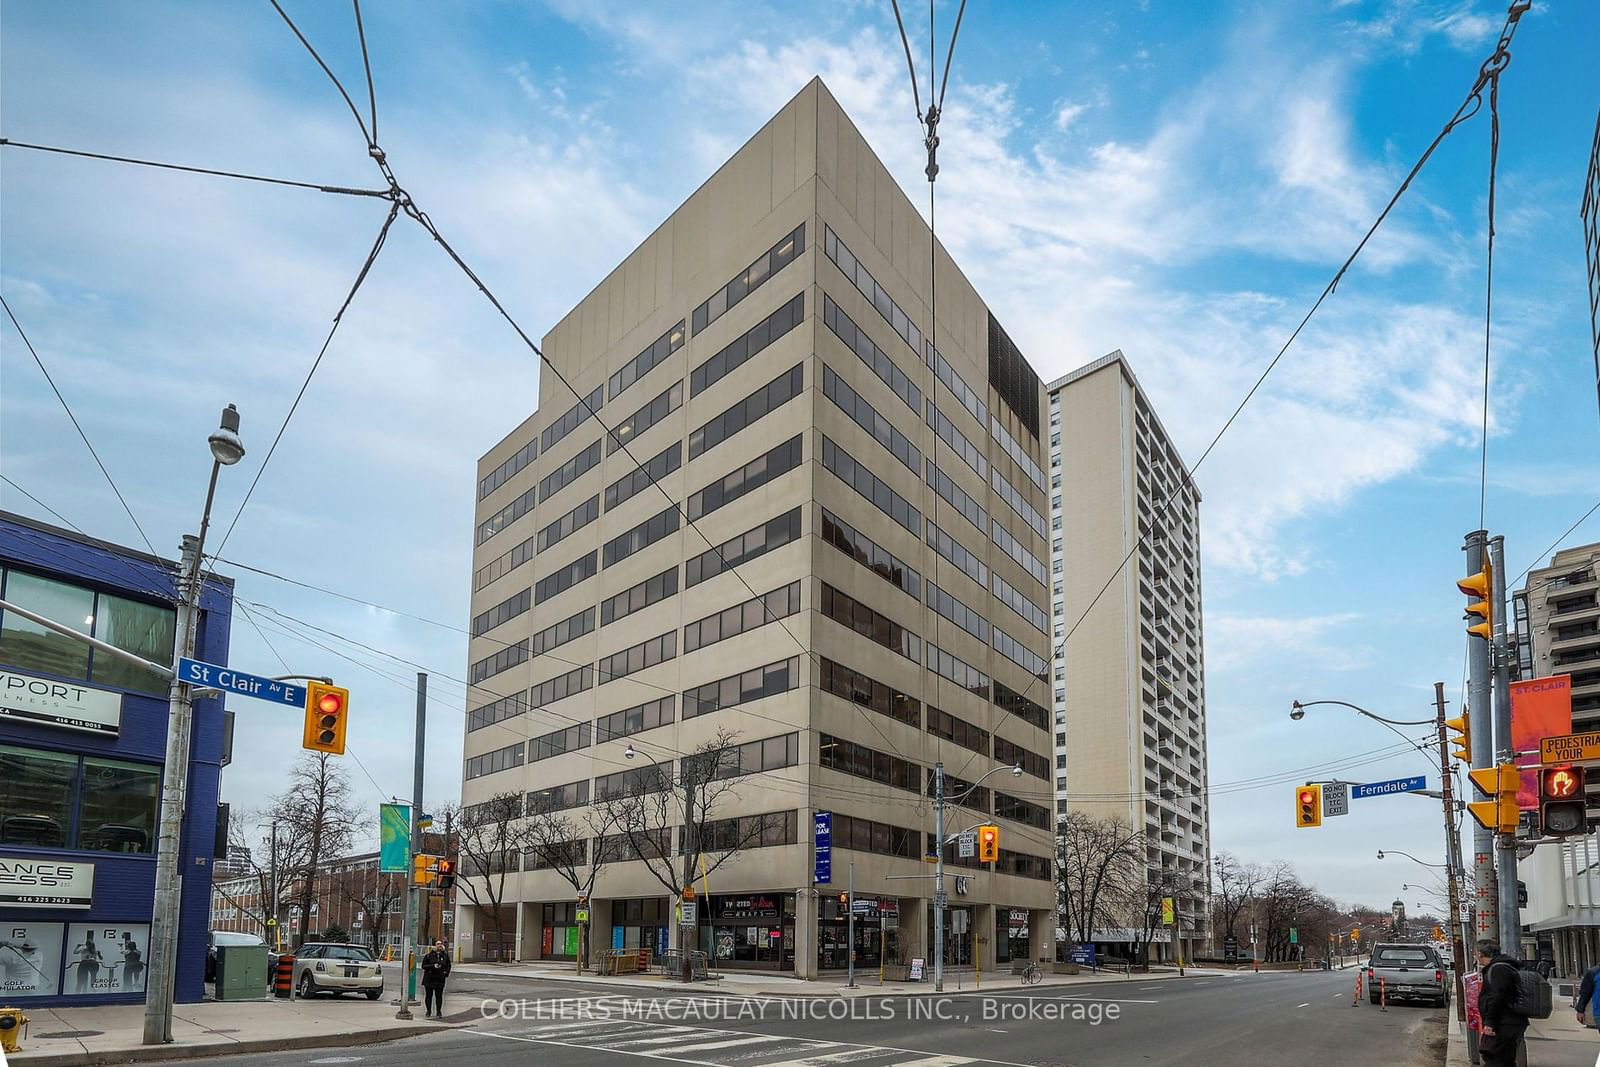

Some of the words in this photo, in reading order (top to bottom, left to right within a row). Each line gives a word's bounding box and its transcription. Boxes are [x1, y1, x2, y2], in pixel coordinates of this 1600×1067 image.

[0, 675, 88, 702] PORT
[190, 664, 210, 682] St
[218, 671, 262, 694] Clair
[269, 683, 281, 692] Av
[284, 687, 295, 702] E
[1532, 681, 1566, 692] CLAIR
[1555, 748, 1583, 760] YOUR
[1333, 784, 1345, 792] NOT
[1360, 781, 1408, 796] Ferndale
[1323, 791, 1345, 800] BLOCK
[1329, 806, 1342, 814] EXIT
